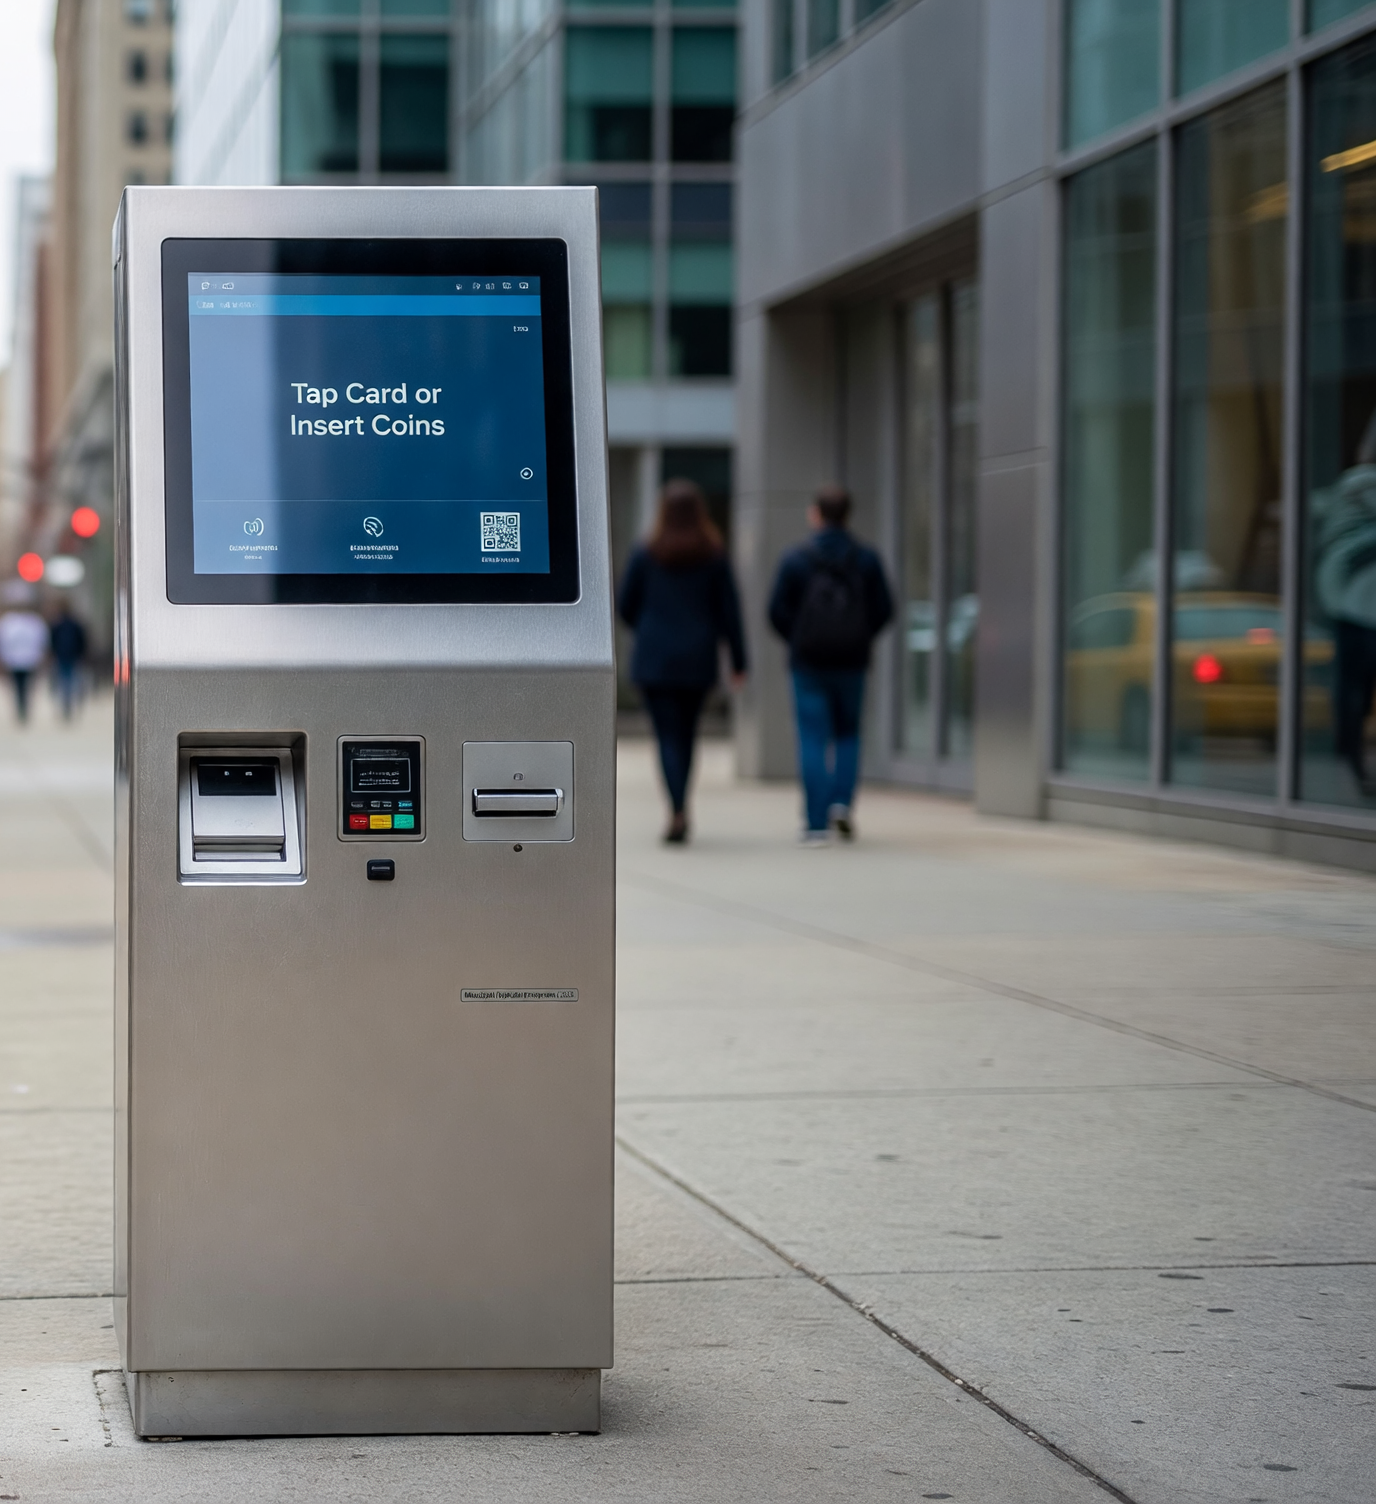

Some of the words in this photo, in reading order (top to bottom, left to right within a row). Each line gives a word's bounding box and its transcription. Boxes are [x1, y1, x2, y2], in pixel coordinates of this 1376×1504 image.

[290, 382, 339, 408] Tap
[345, 382, 408, 404] Card
[415, 387, 442, 404] or
[290, 414, 365, 436] Insert
[371, 413, 445, 436] Coins
